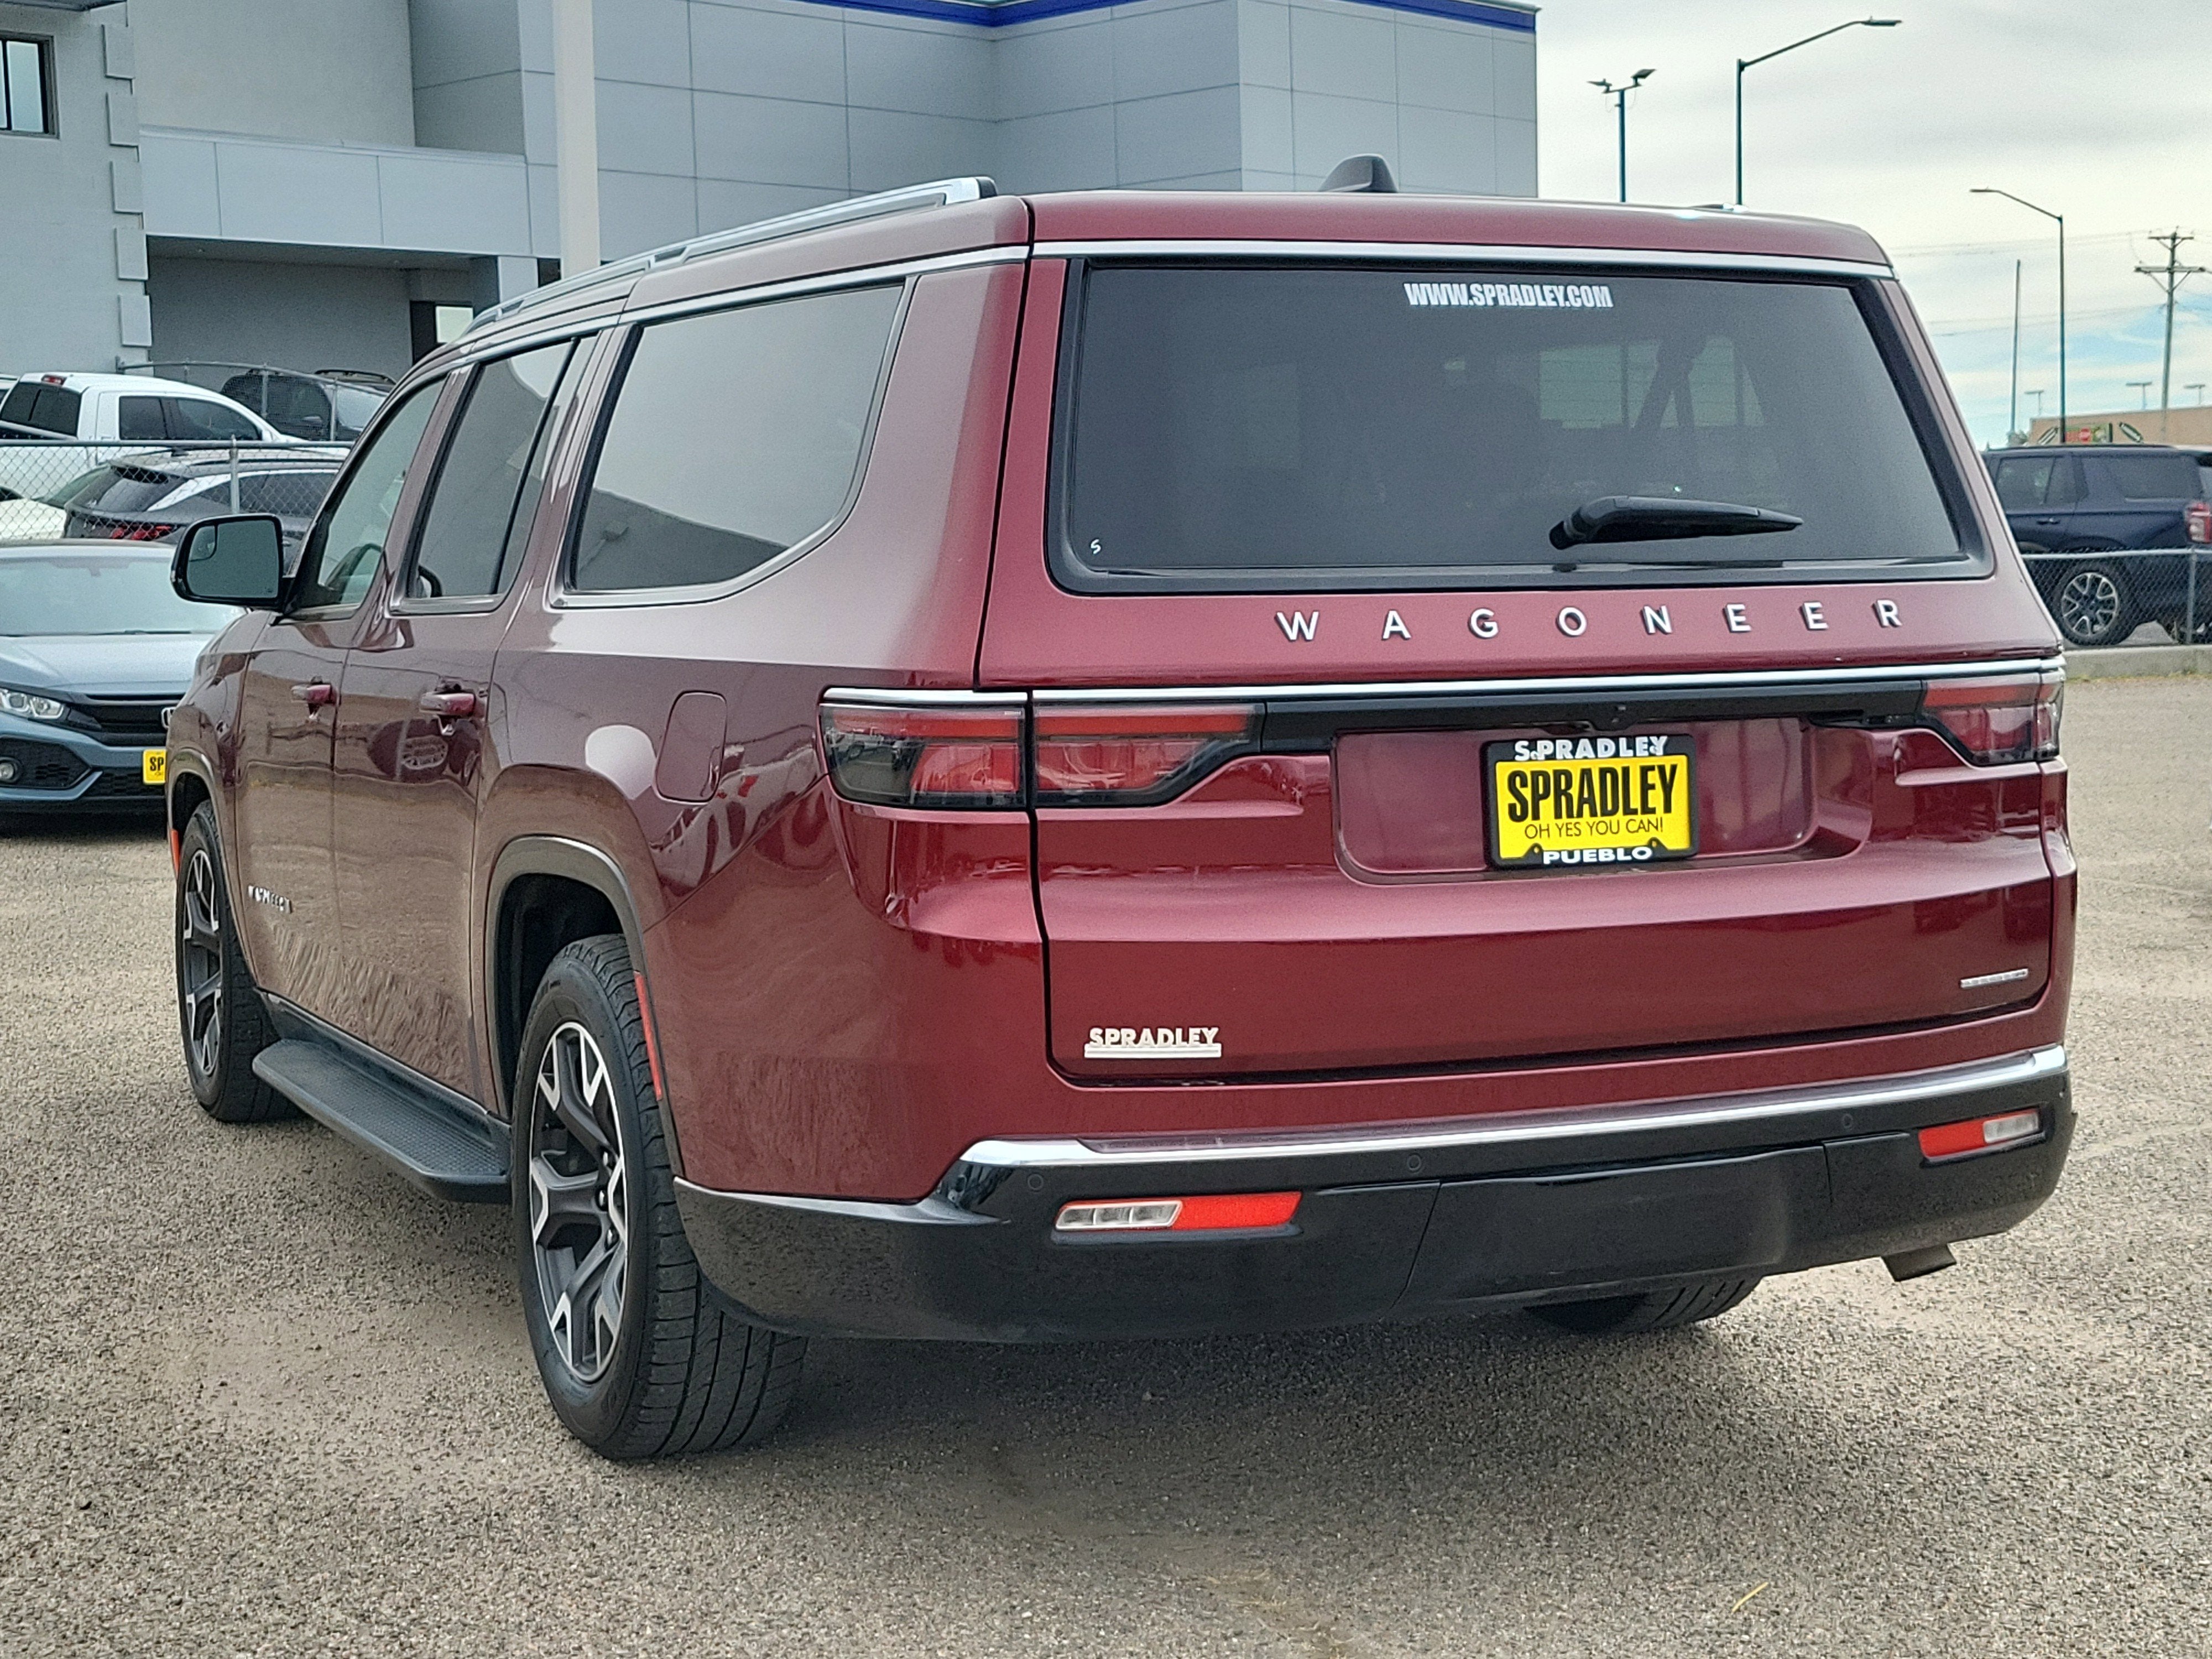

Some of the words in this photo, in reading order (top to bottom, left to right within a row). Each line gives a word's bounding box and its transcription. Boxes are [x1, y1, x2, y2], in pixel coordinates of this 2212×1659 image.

[1403, 283, 1614, 308] WWW.SPRADLEY.COM
[1274, 599, 1903, 642] WAGONEER
[1514, 735, 1668, 761] SPRADLEY
[1507, 764, 1678, 823] SPRADLEY
[1524, 823, 1550, 839] OH
[1555, 821, 1582, 838] YES
[1586, 819, 1620, 836] YOU
[1625, 817, 1663, 833] CAN!
[1543, 847, 1652, 864] PUEBLO
[1089, 1027, 1219, 1047] SPRADLEY
